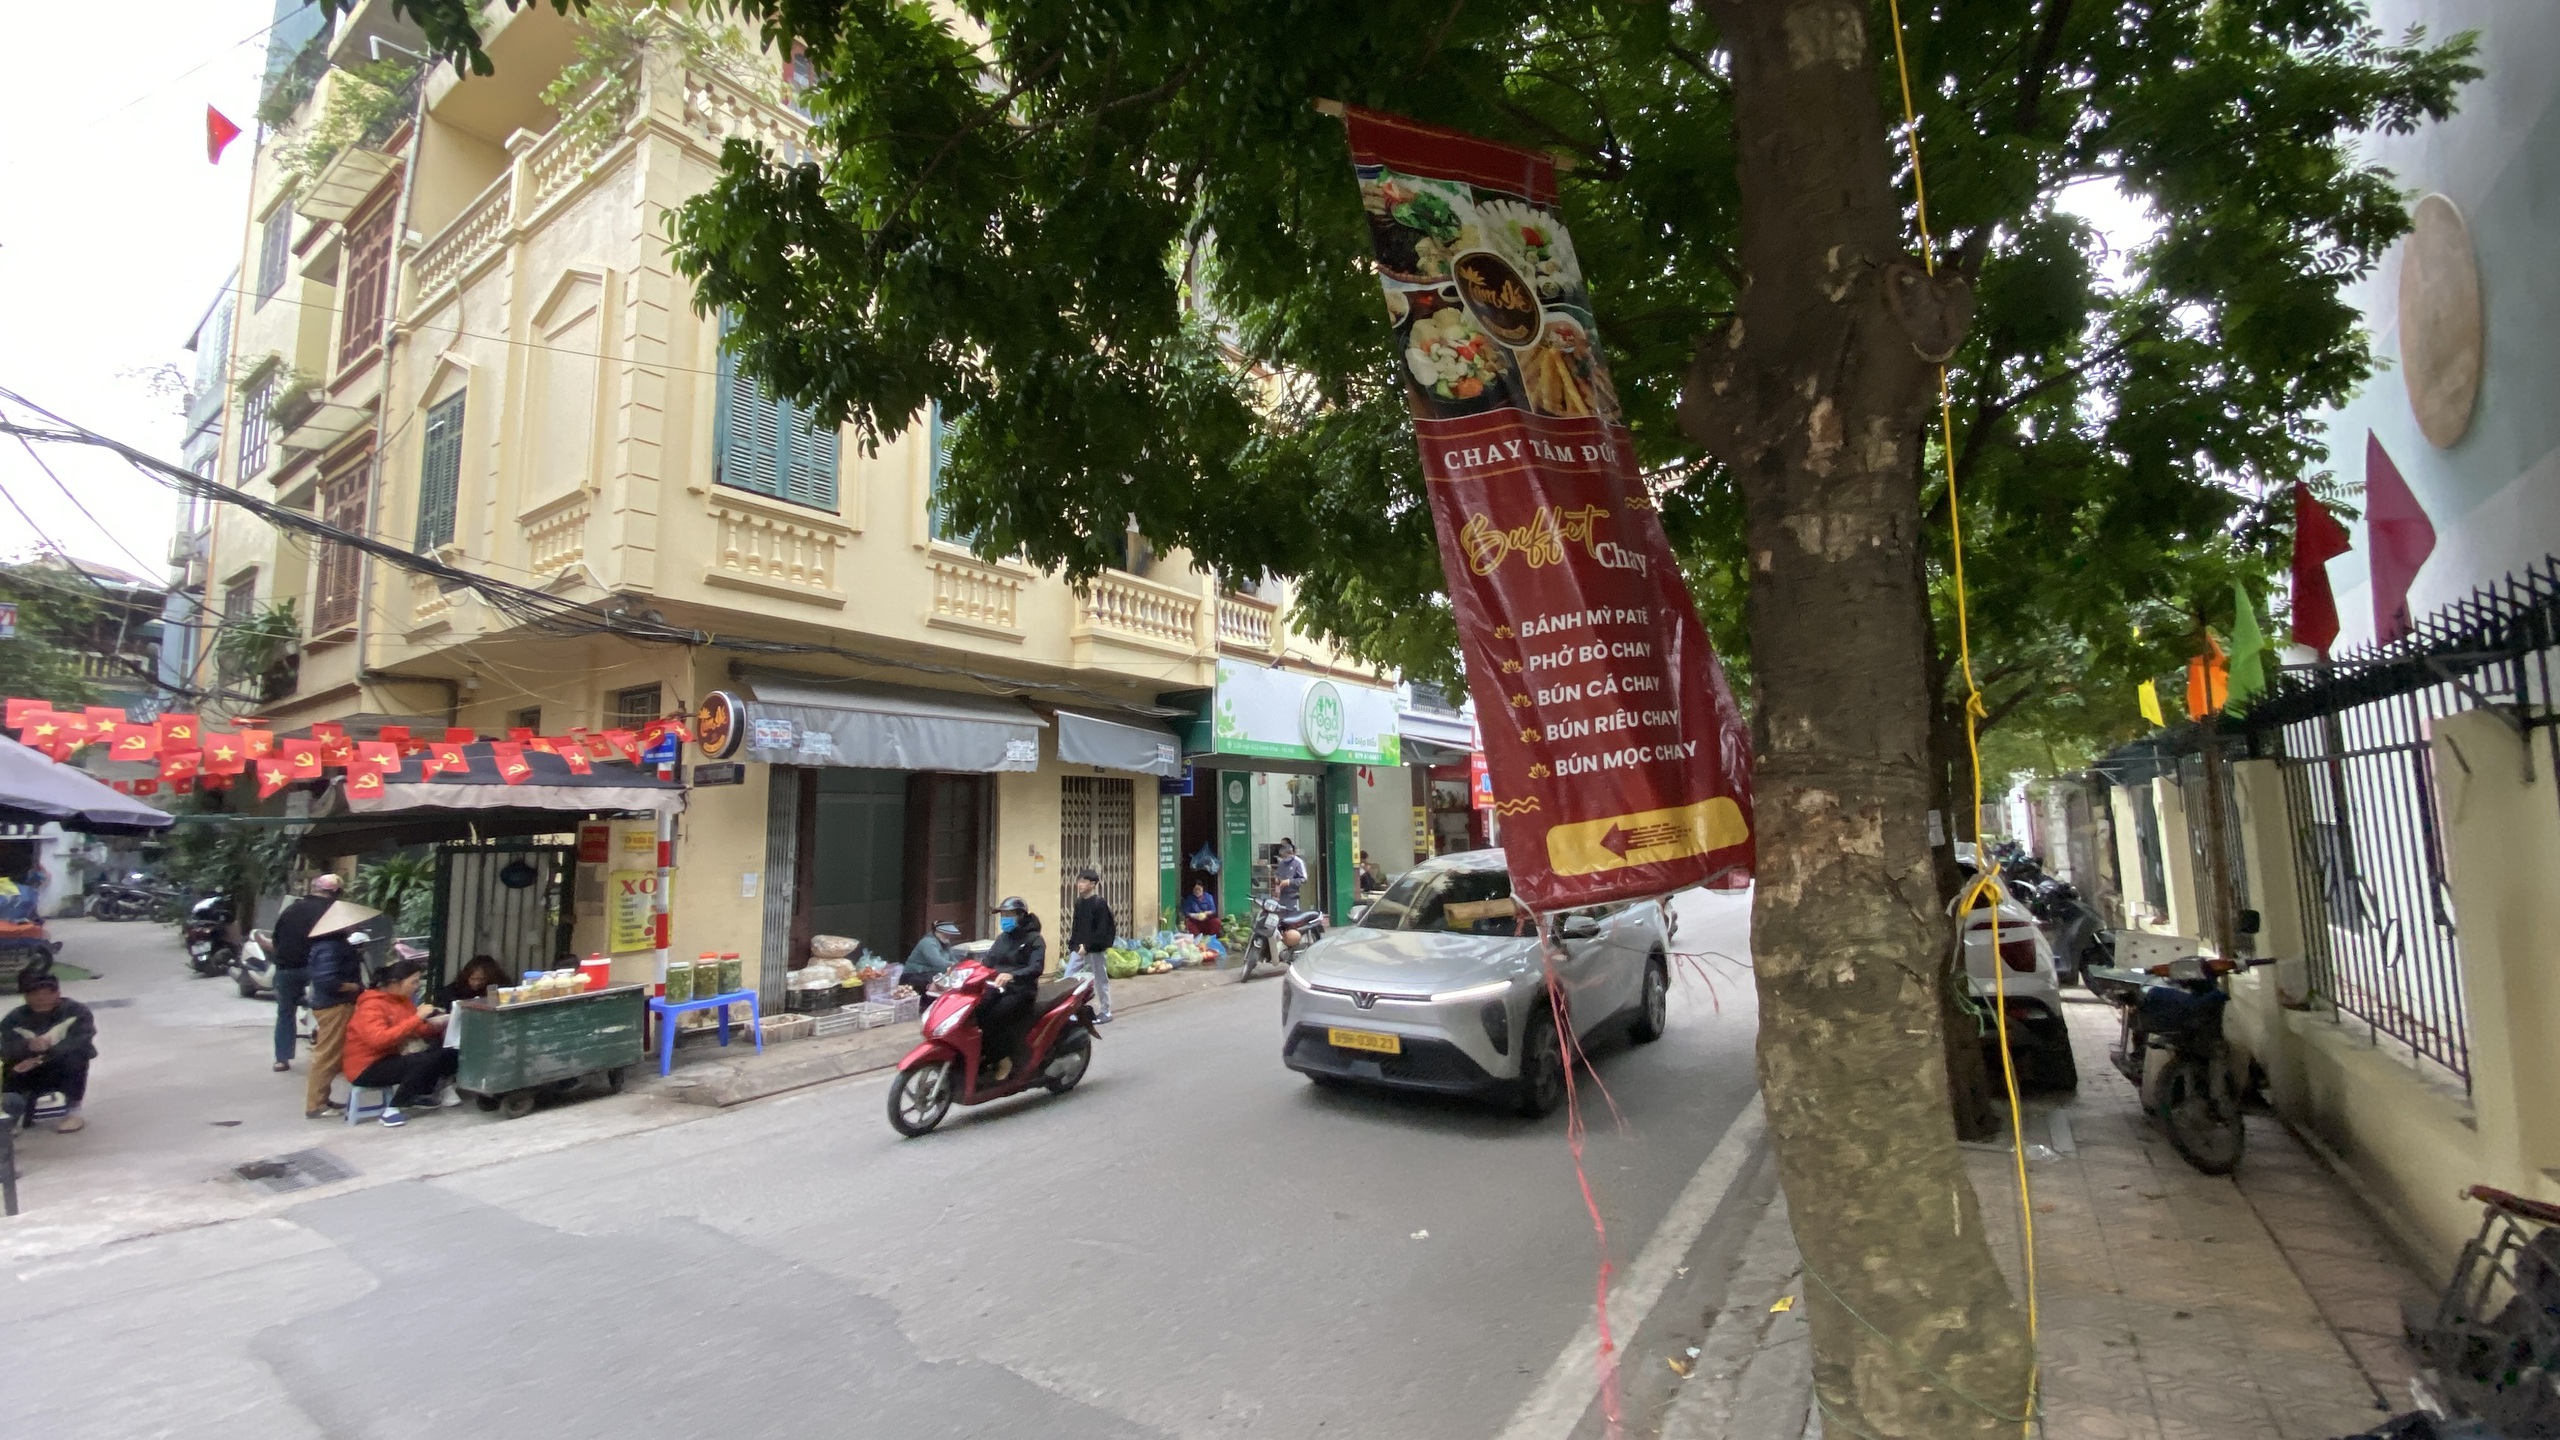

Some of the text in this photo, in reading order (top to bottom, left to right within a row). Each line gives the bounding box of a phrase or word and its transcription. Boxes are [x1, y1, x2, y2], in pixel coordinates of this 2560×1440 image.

[1444, 439, 1522, 469] CHAY
[1529, 440, 1576, 463] TÂM
[1460, 504, 1610, 576] Buffet
[1595, 542, 1648, 577] Chay
[1521, 605, 1649, 637] BÁNH MỲ PATÊ
[1529, 639, 1651, 671] PHỞ BÒ CHAY
[1537, 673, 1660, 706] BÚN CÁ CHAY
[1546, 708, 1680, 741] BÚN RIÊU CHAY
[1555, 740, 1696, 776] BÚN MỌC CHAY
[620, 870, 658, 896] XÔ
